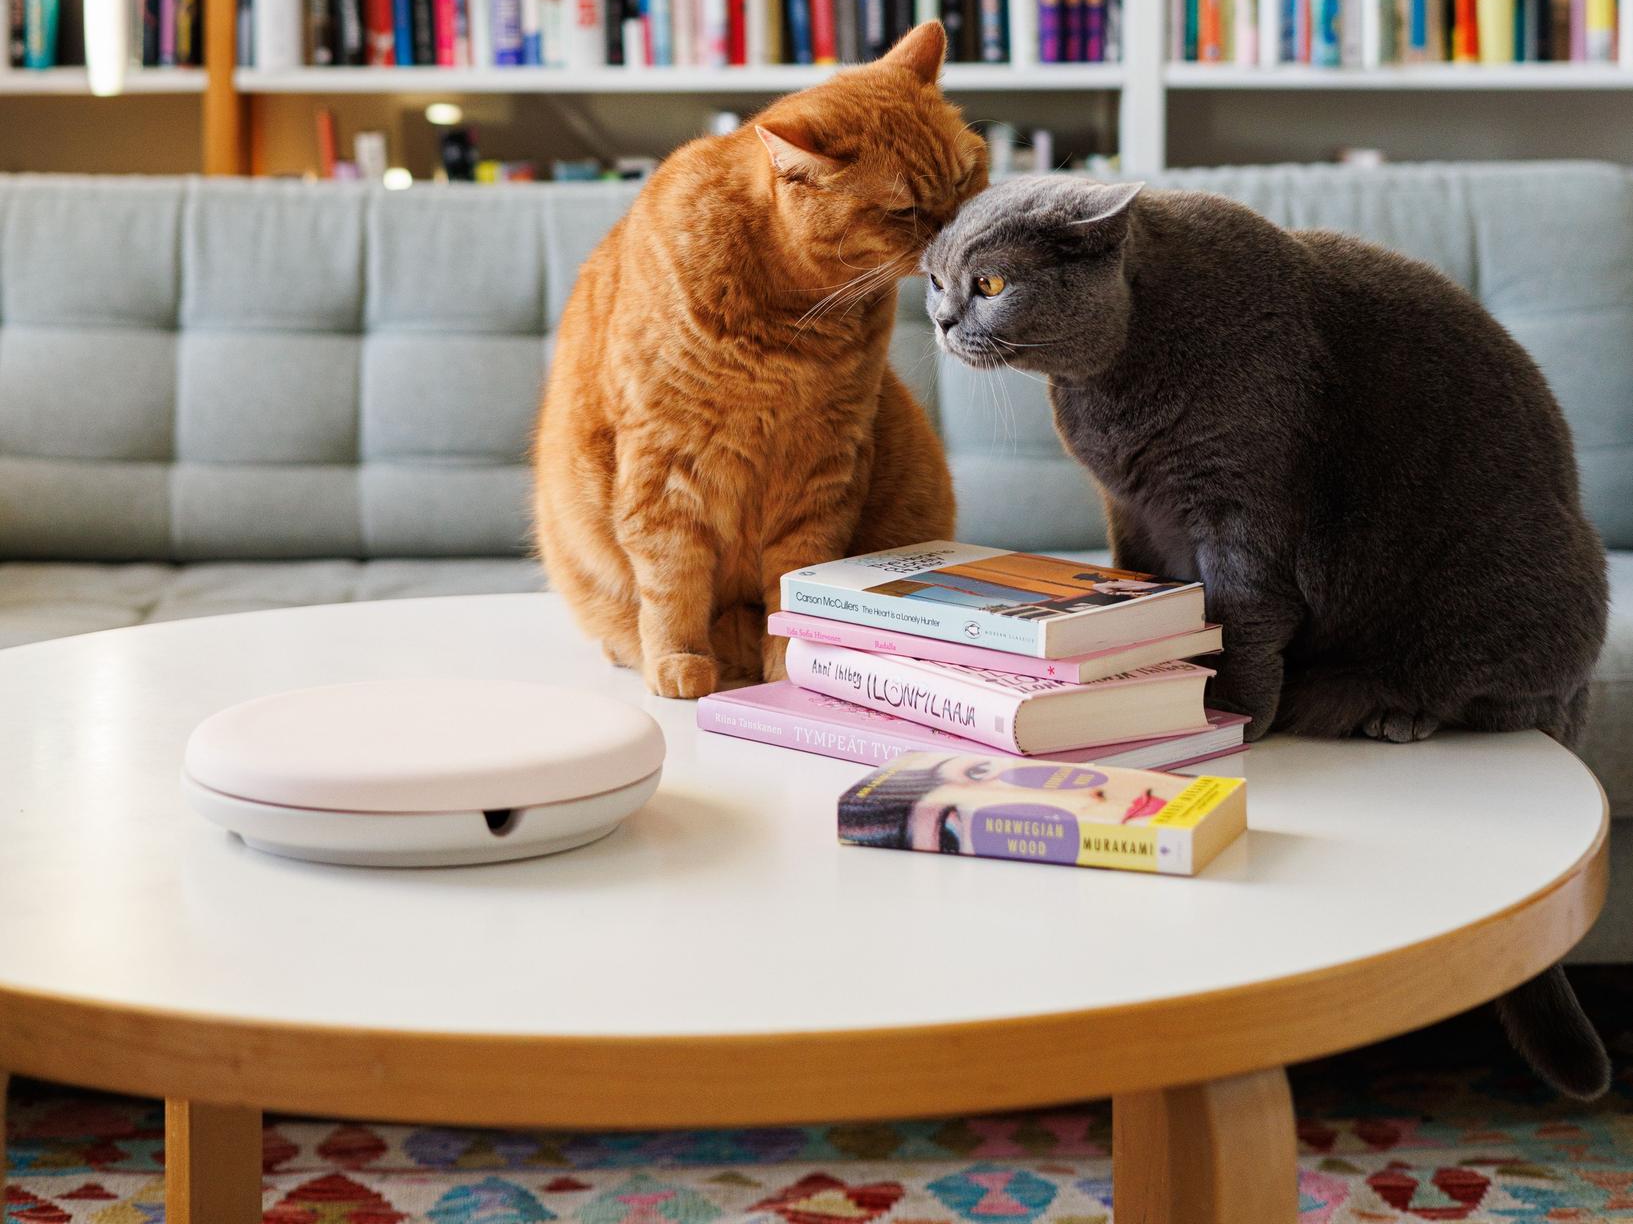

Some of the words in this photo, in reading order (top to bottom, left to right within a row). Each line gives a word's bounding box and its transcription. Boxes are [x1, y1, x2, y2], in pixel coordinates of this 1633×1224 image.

[796, 591, 822, 605] Carson
[823, 597, 859, 612] McCullers
[862, 605, 873, 615] The
[874, 607, 890, 618] Heart
[891, 610, 896, 619] is
[901, 613, 920, 624] Lonely
[921, 615, 941, 627] Hunter
[812, 658, 831, 677] Anni
[714, 712, 737, 727] Riina
[793, 726, 867, 755] TYMPEÄT
[871, 742, 911, 760] TYT
[985, 817, 1064, 838] NORWEGIAN
[1007, 838, 1047, 857] WOOD
[1082, 837, 1154, 857] MURAKAMI
